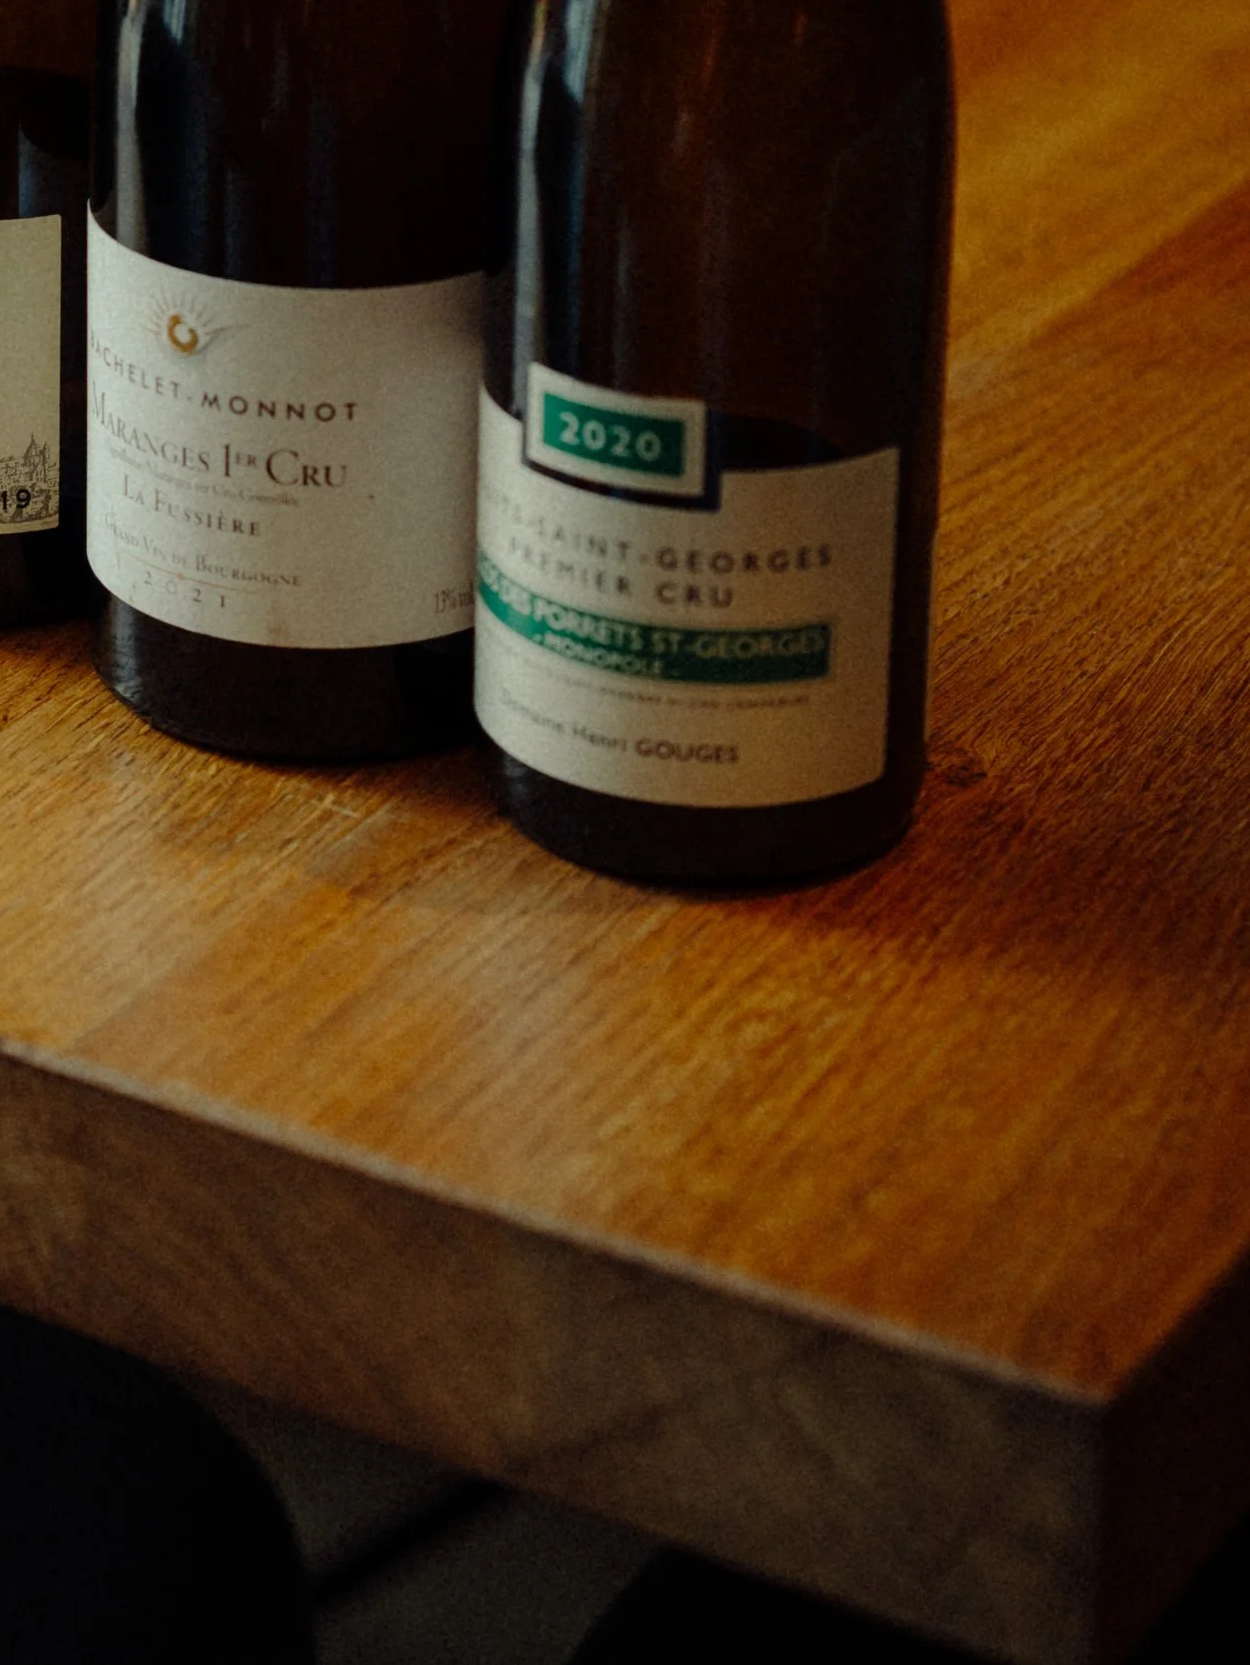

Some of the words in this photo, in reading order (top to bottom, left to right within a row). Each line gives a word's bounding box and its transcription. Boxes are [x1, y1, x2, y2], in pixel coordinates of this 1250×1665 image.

[557, 410, 663, 463] 2020
[263, 447, 350, 489] CRU
[122, 473, 145, 507] LA
[153, 488, 263, 538] FUSSIÈRE
[654, 579, 735, 610] CRU
[634, 735, 740, 766] GOUGES
